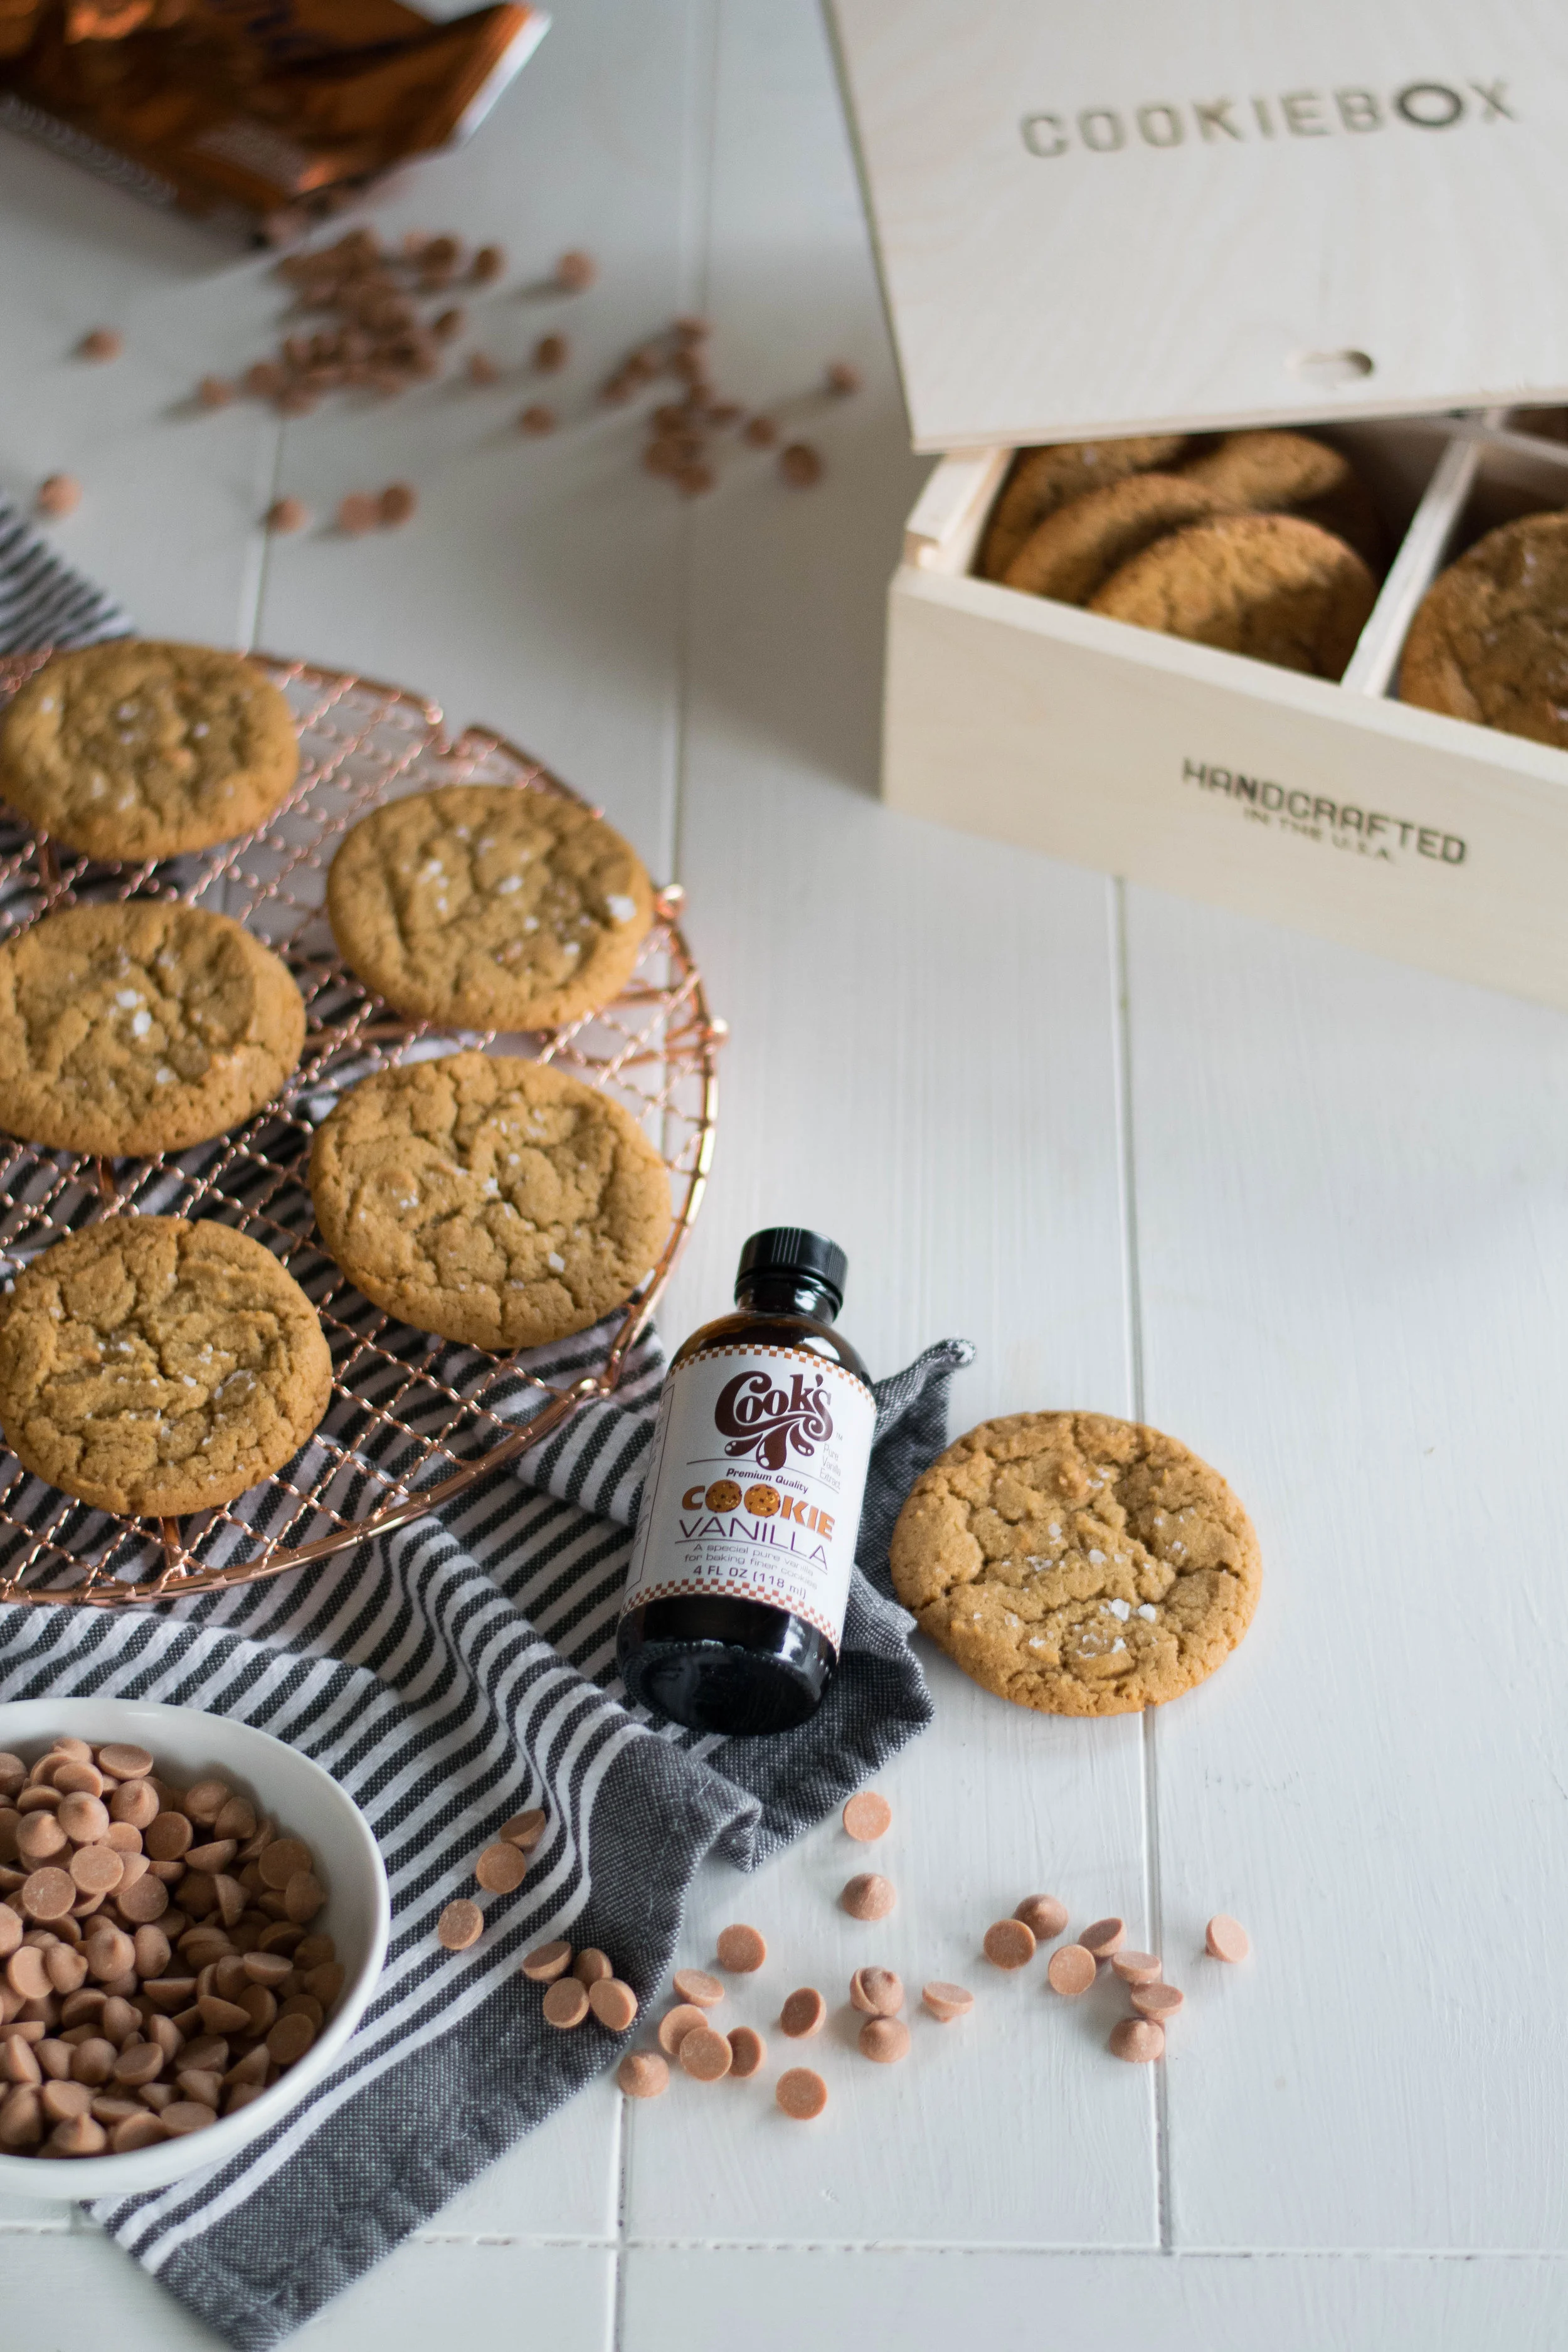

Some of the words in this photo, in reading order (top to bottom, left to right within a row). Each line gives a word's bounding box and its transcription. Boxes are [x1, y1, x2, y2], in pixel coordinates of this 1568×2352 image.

[1019, 78, 1517, 158] COOKIEBOX
[1180, 757, 1468, 866] HANDCRAFTED
[1244, 807, 1271, 826] IN
[1279, 817, 1323, 842] THE
[714, 1370, 834, 1443] Cook's
[822, 1454, 841, 1477] Vanilla
[824, 1443, 839, 1461] Pure
[726, 1468, 771, 1481] Premium
[775, 1475, 809, 1494] Quality
[819, 1466, 841, 1490] Extract
[682, 1479, 835, 1543] COOKIE
[679, 1516, 828, 1571] VANILLA
[693, 1544, 703, 1552] A
[707, 1544, 749, 1555] special
[752, 1550, 780, 1562] pure
[784, 1558, 814, 1577] vanilla
[684, 1553, 703, 1562] for
[706, 1553, 746, 1565] baking
[750, 1557, 778, 1571] finer
[781, 1567, 818, 1590] cookies
[693, 1565, 702, 1576] 4
[707, 1566, 724, 1576] FL
[729, 1567, 748, 1579] OZ
[753, 1571, 785, 1589] (118
[789, 1584, 807, 1599] ml)
